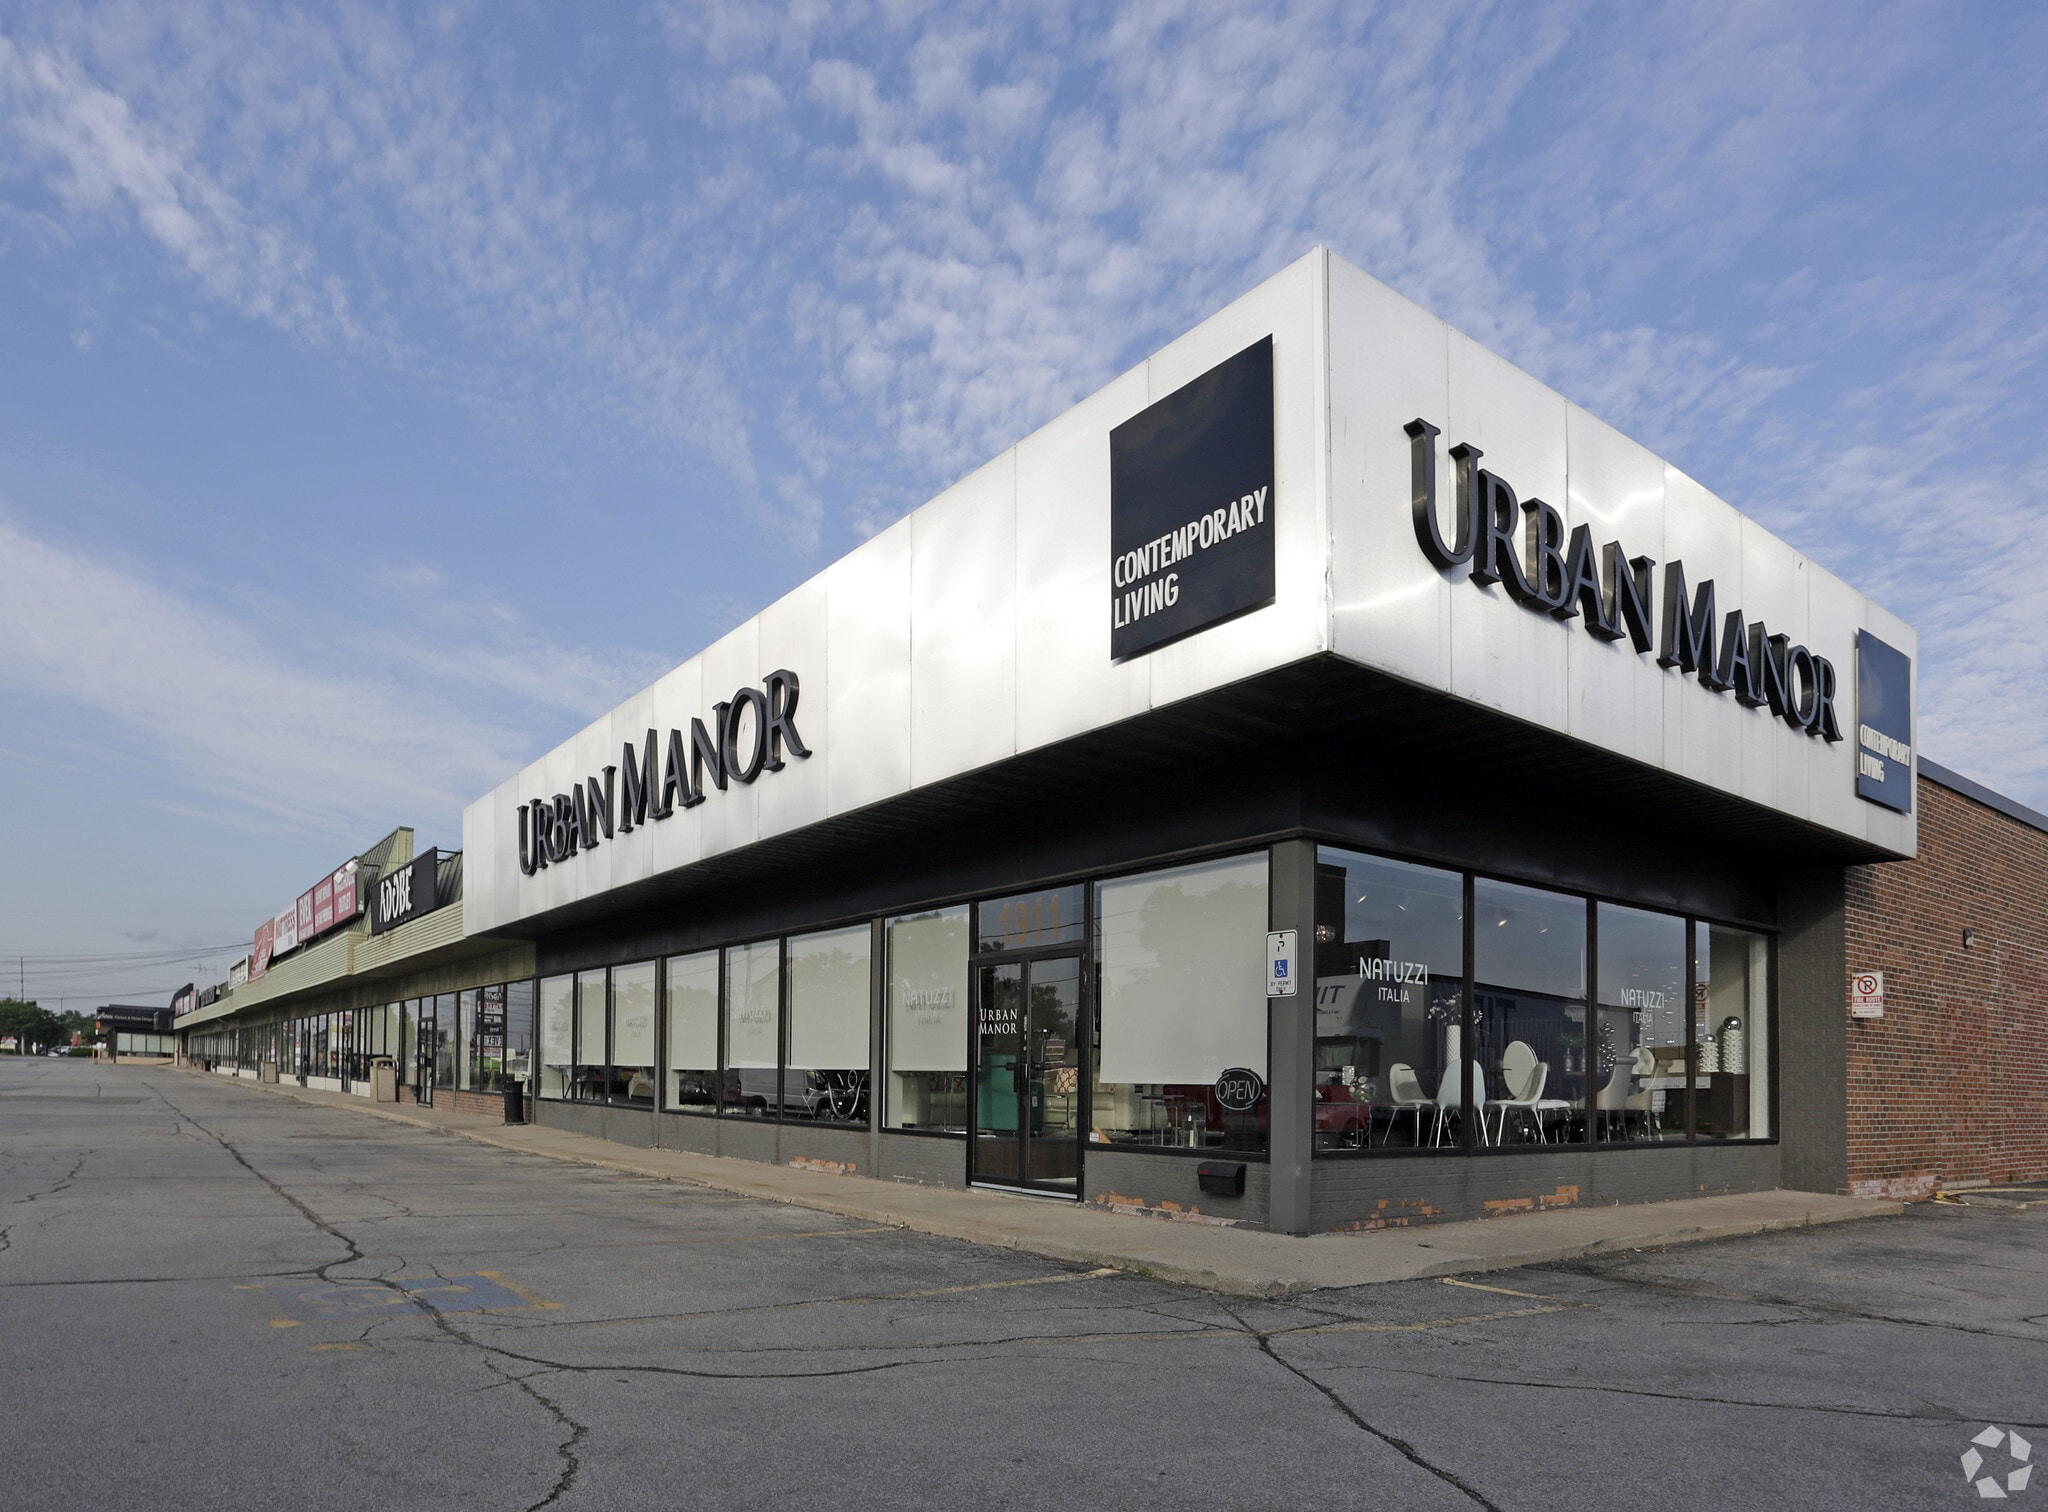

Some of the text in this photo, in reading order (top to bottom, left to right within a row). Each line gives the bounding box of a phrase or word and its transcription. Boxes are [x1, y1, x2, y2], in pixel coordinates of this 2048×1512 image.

[1114, 486, 1268, 588] CONTEMPORARY
[1403, 417, 1844, 742] URBAN MANOR
[1114, 573, 1179, 630] LIVING
[516, 668, 813, 876] URBAN MANOR
[379, 864, 413, 923] ADOBE
[999, 894, 1060, 945] 1911
[1359, 956, 1429, 986] NATUZZI
[1378, 986, 1410, 1003] ITALIA
[1620, 987, 1665, 1009] NATUZZI
[980, 1008, 1018, 1022] URBAN
[980, 1022, 1018, 1035] MANOR
[1218, 1080, 1256, 1100] OPEN
